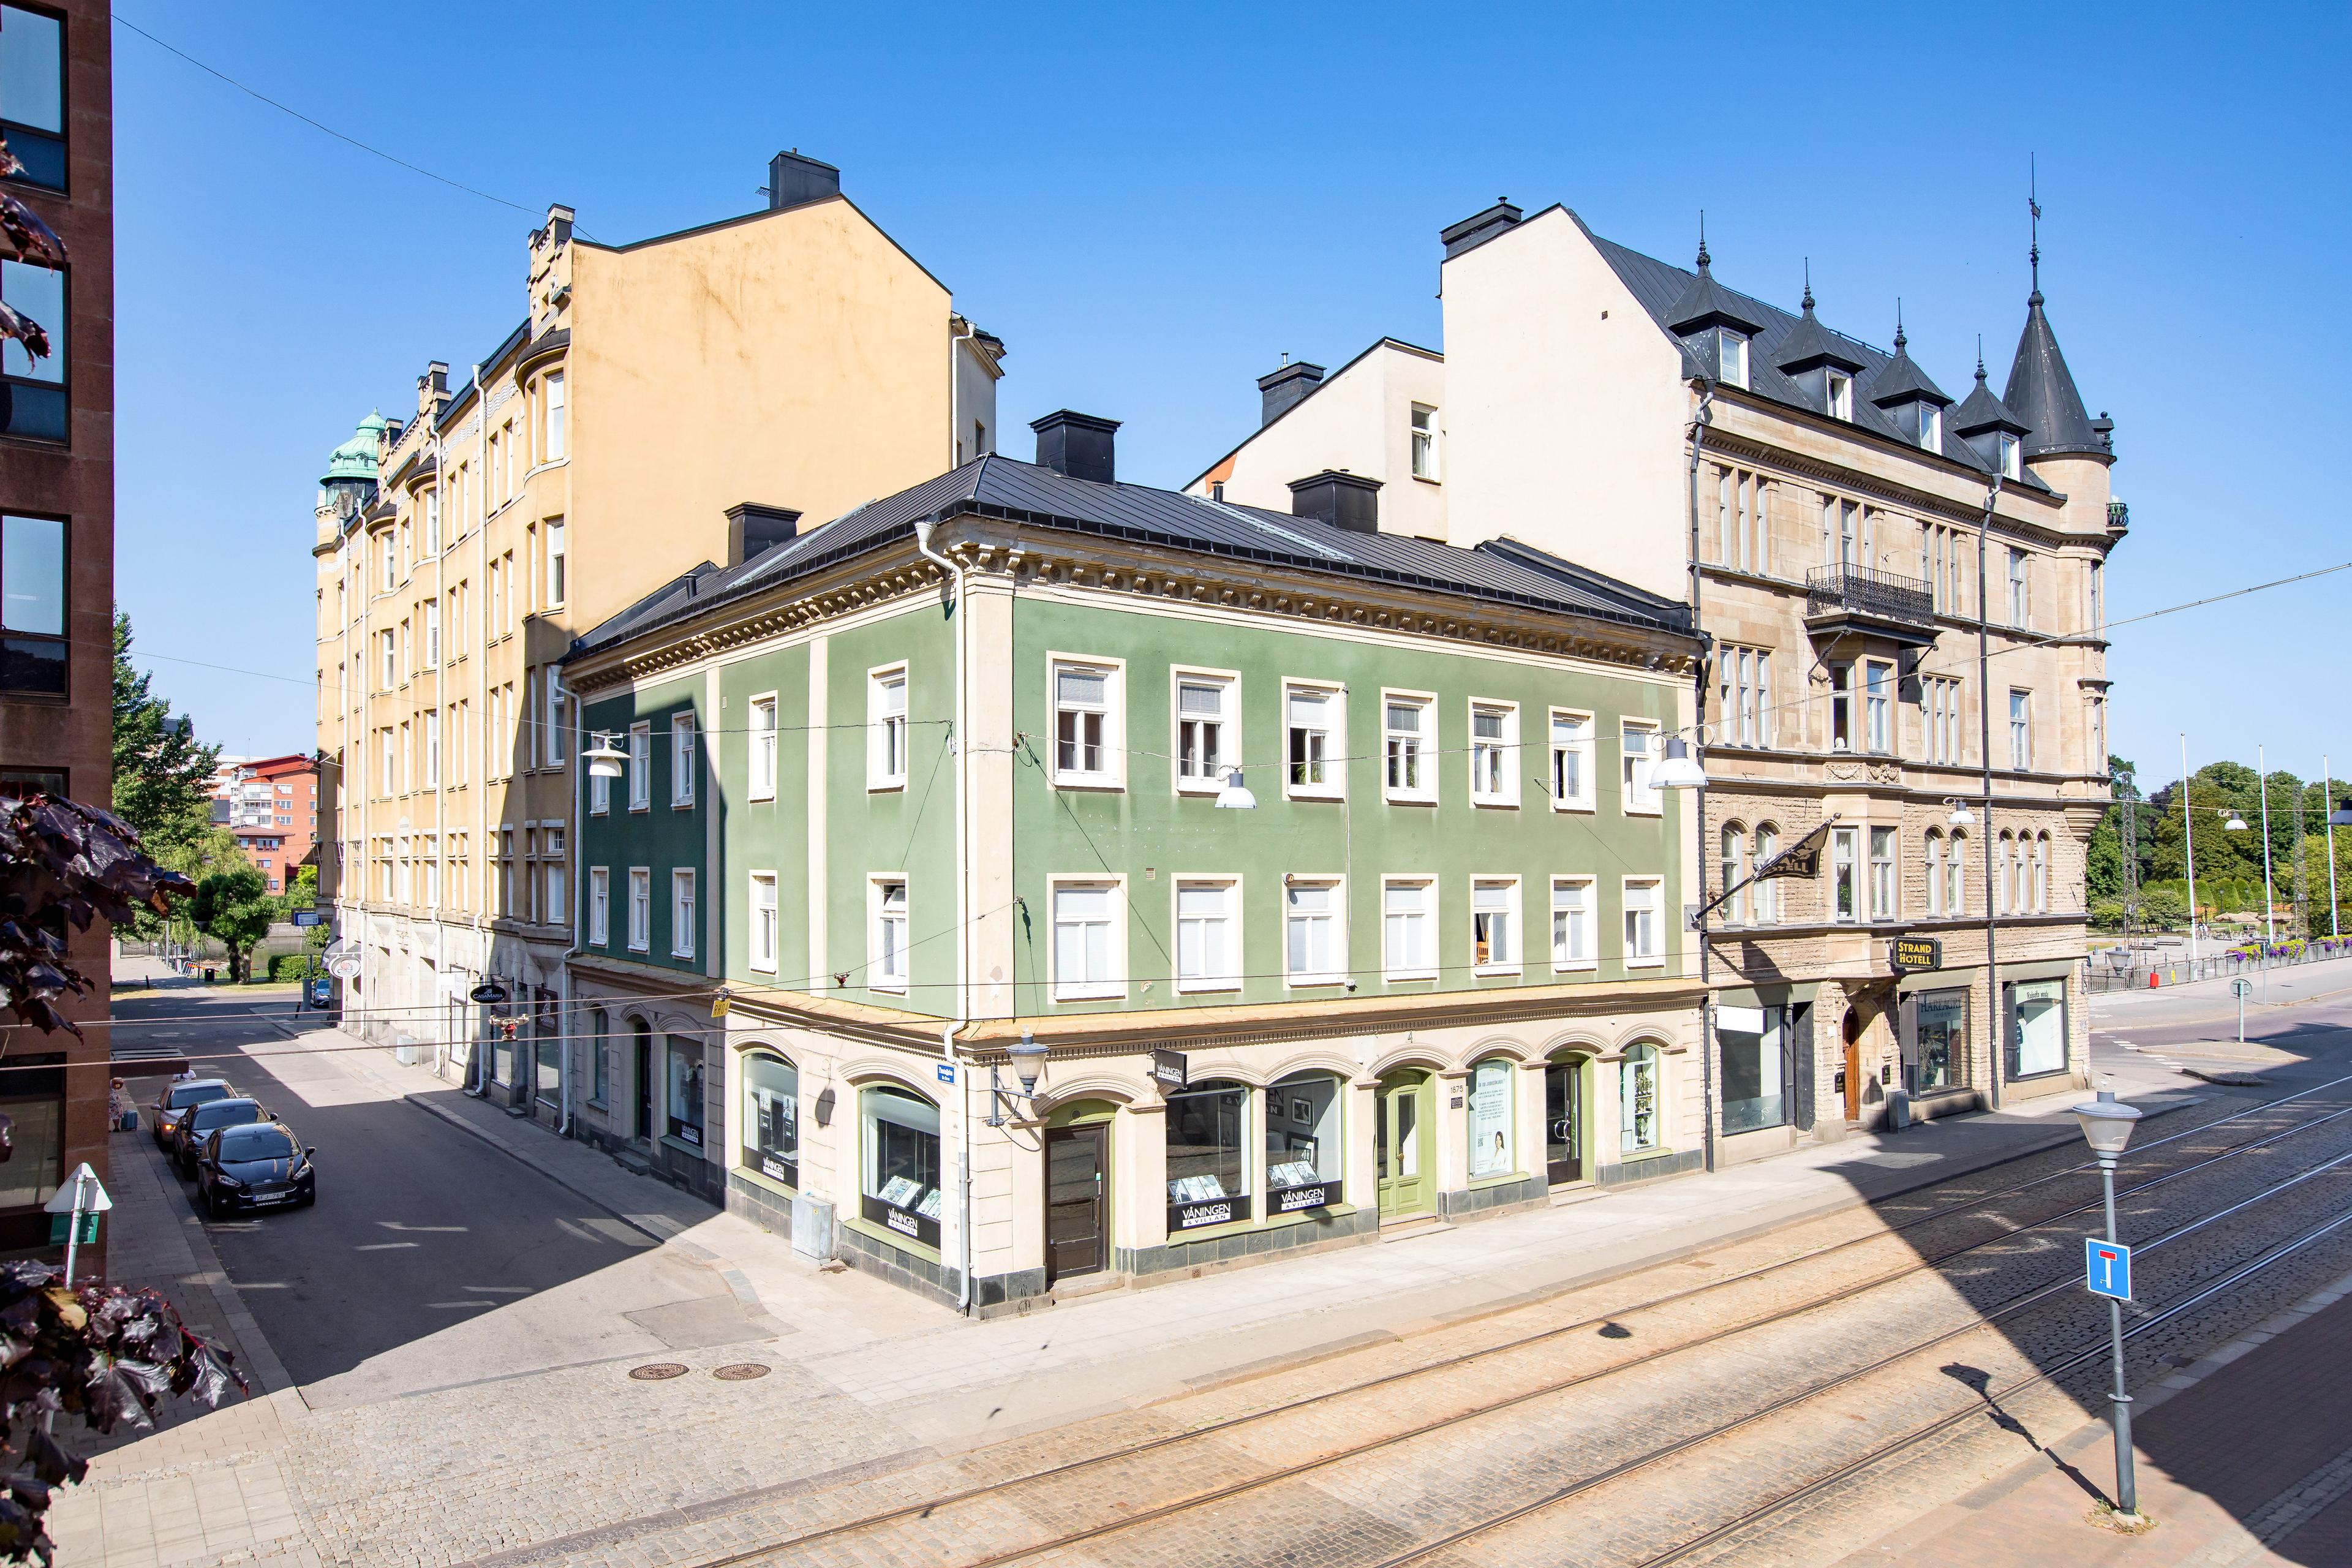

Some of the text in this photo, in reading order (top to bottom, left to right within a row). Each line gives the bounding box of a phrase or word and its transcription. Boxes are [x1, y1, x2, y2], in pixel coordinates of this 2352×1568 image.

[1898, 941, 1932, 953] STRAND
[1899, 953, 1931, 965] HOTELL
[1157, 1063, 1182, 1077] VÅNINGEN
[1450, 1085, 1464, 1093] 1875
[1281, 1188, 1324, 1204] VÅNINGEN
[1182, 1202, 1231, 1219] VÅNINGEN
[888, 1207, 918, 1229] VÅNINGEN
[1194, 1215, 1226, 1223] VILLAN
